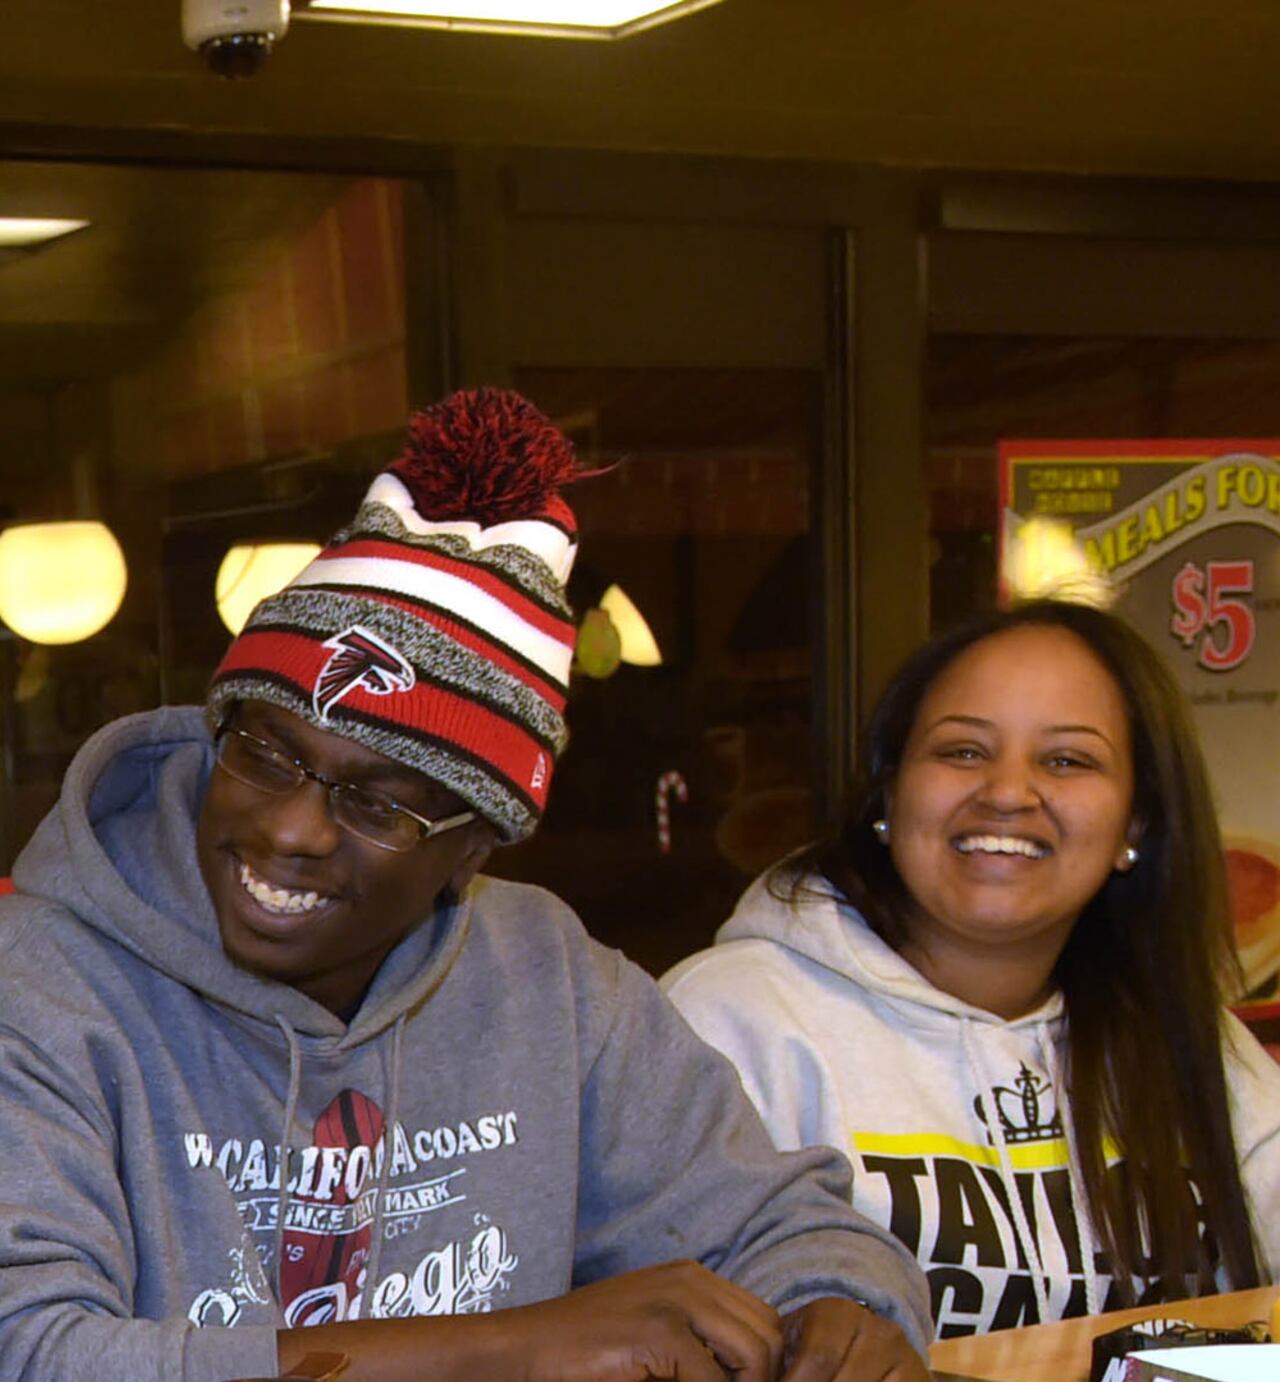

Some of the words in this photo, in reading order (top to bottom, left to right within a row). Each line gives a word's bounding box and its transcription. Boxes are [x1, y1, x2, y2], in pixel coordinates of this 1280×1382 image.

[1084, 477, 1208, 570] MEALS
[1172, 562, 1256, 670] $5
[414, 1111, 518, 1162] COAST
[384, 1181, 451, 1212] MARK
